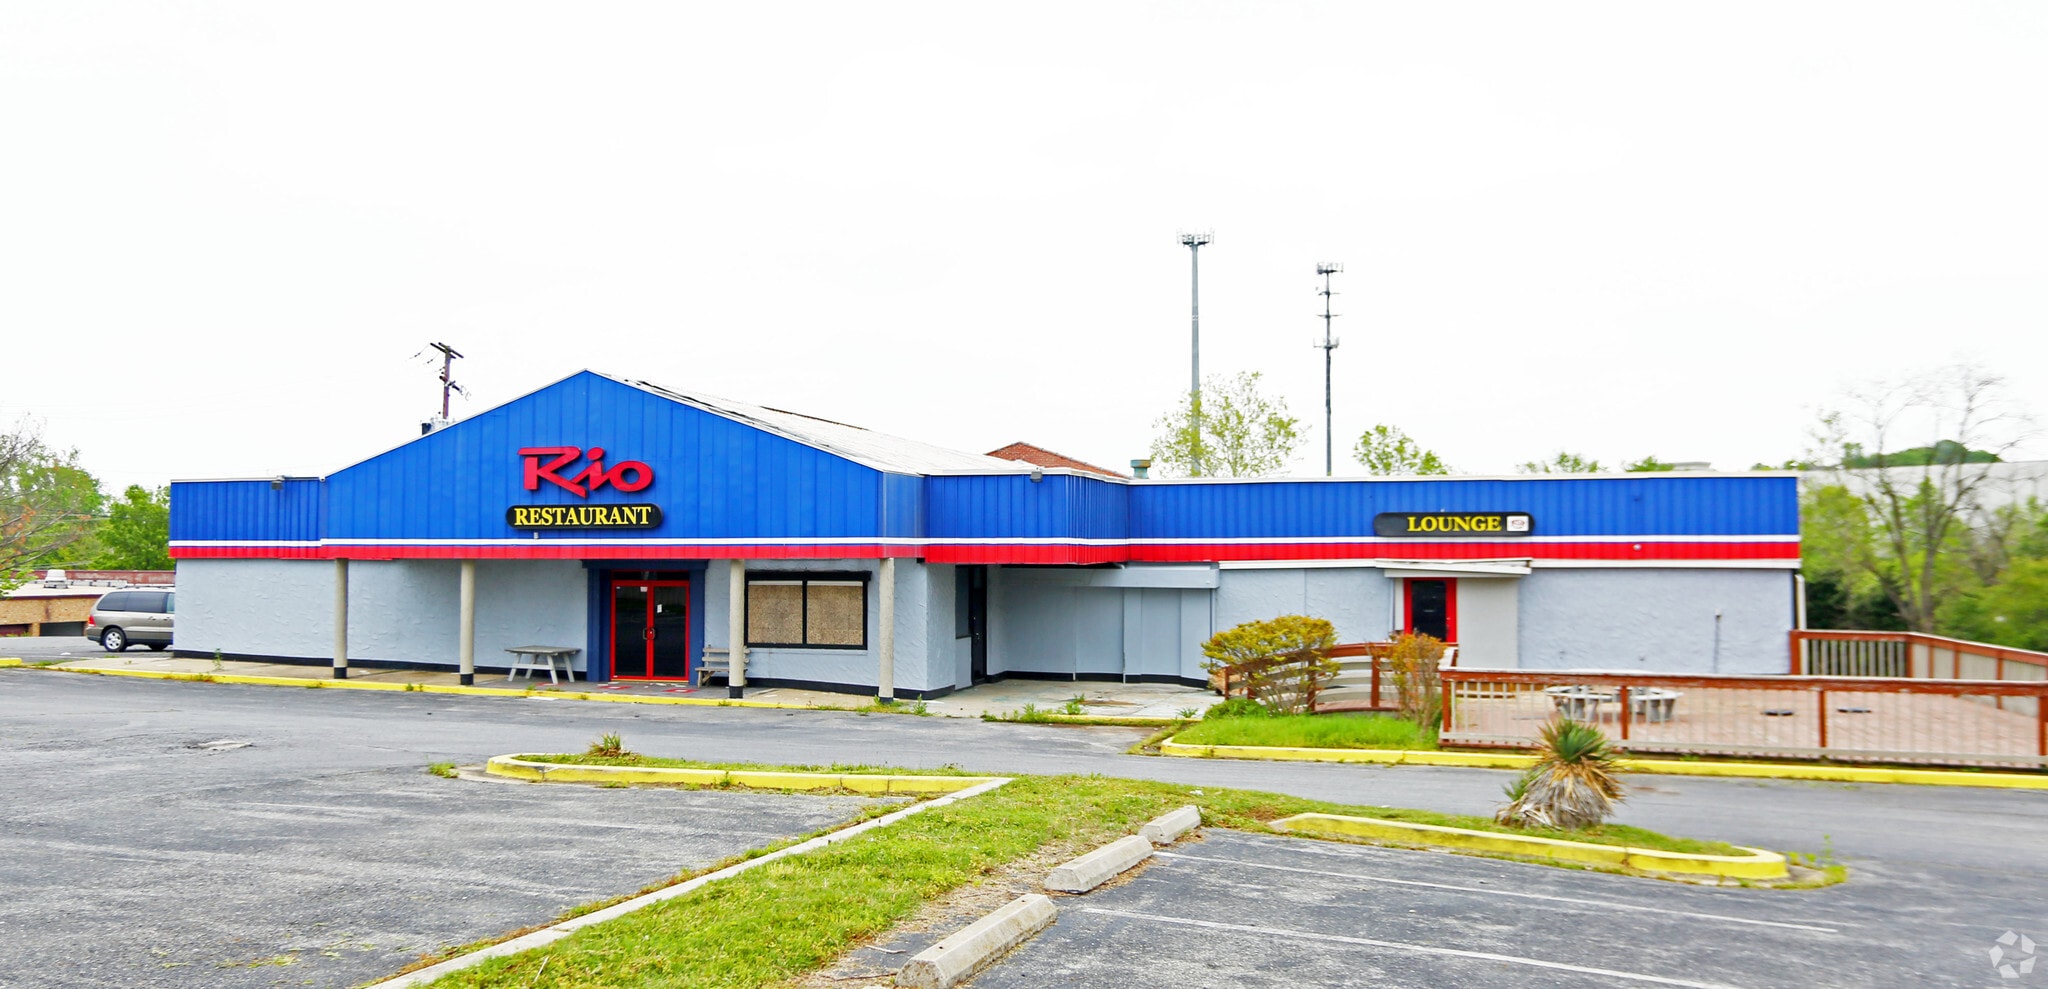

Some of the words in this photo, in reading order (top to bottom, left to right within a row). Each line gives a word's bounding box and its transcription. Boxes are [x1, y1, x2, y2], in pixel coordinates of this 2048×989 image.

[518, 446, 653, 498] Rio
[514, 506, 652, 526] RESTAURANT
[1407, 515, 1502, 532] LOUNGE
